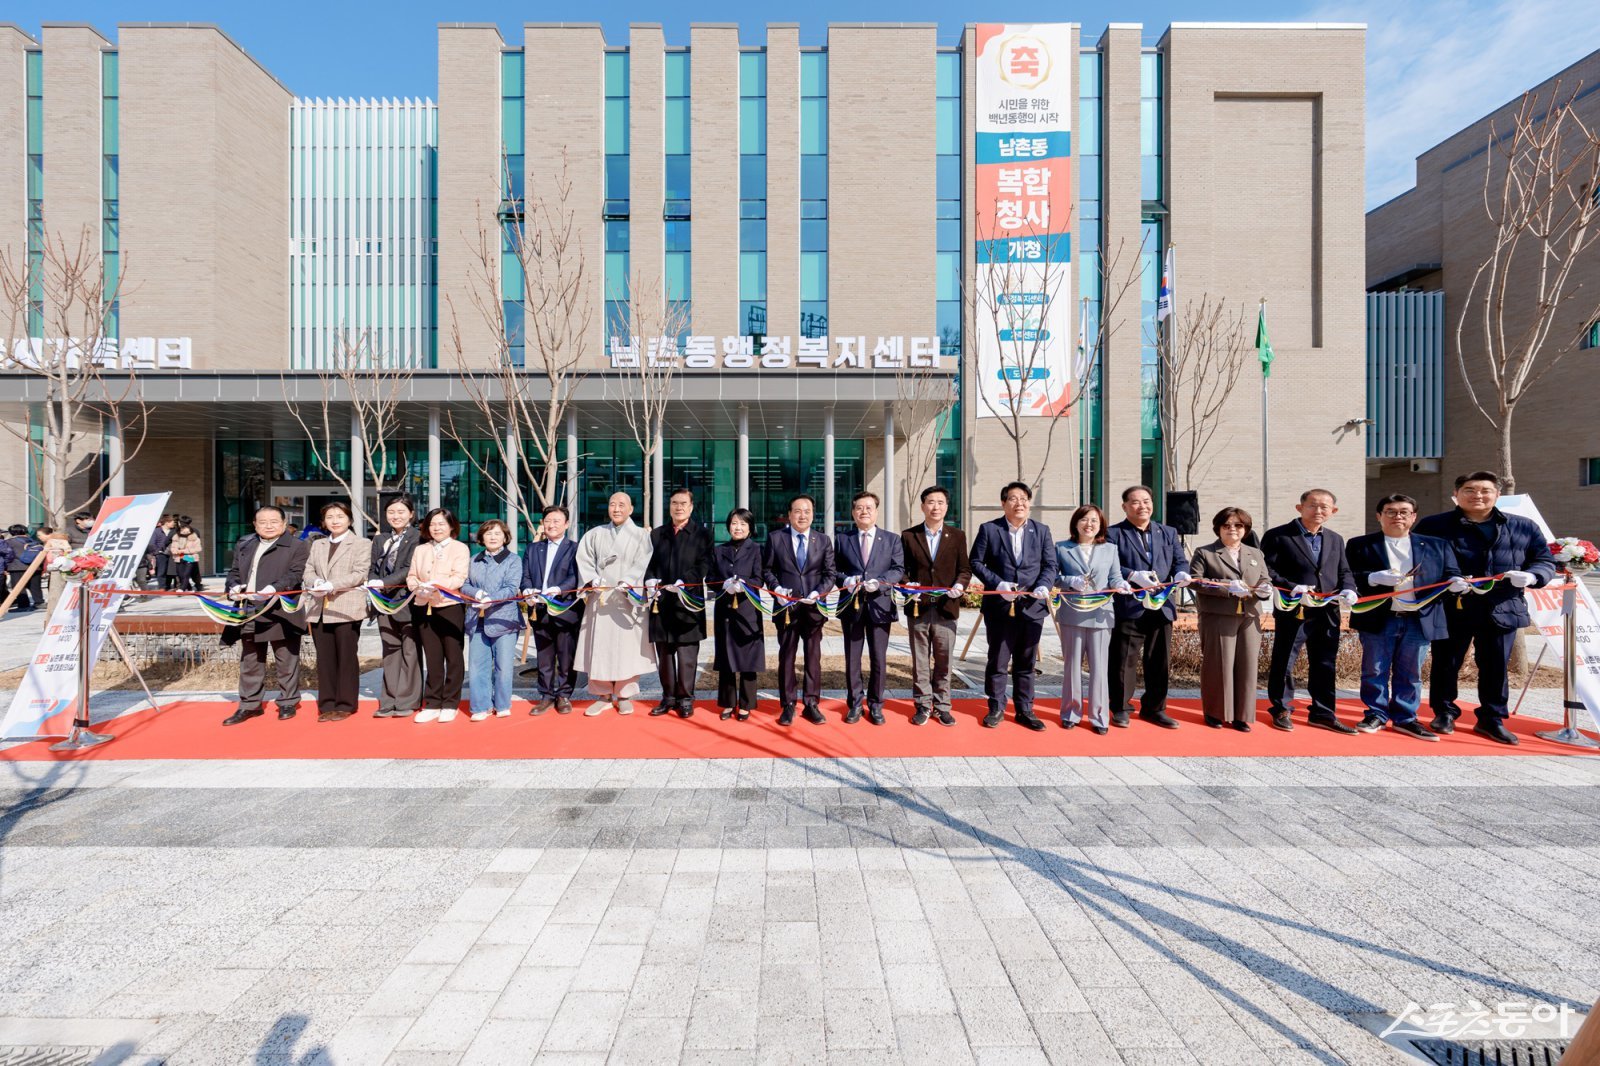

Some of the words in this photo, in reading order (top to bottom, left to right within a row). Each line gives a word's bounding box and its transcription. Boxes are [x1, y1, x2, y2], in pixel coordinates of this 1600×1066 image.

[1010, 46, 1039, 77] 축
[998, 98, 1028, 110] 시민을
[1031, 98, 1050, 110] 위한
[988, 112, 1036, 124] 백년동행의
[1039, 112, 1059, 124] 시작
[999, 138, 1048, 157] 남촌동
[997, 167, 1051, 196] 복합
[996, 200, 1050, 230] 청사
[1009, 240, 1041, 259] 개청
[93, 527, 140, 551] 남촌동
